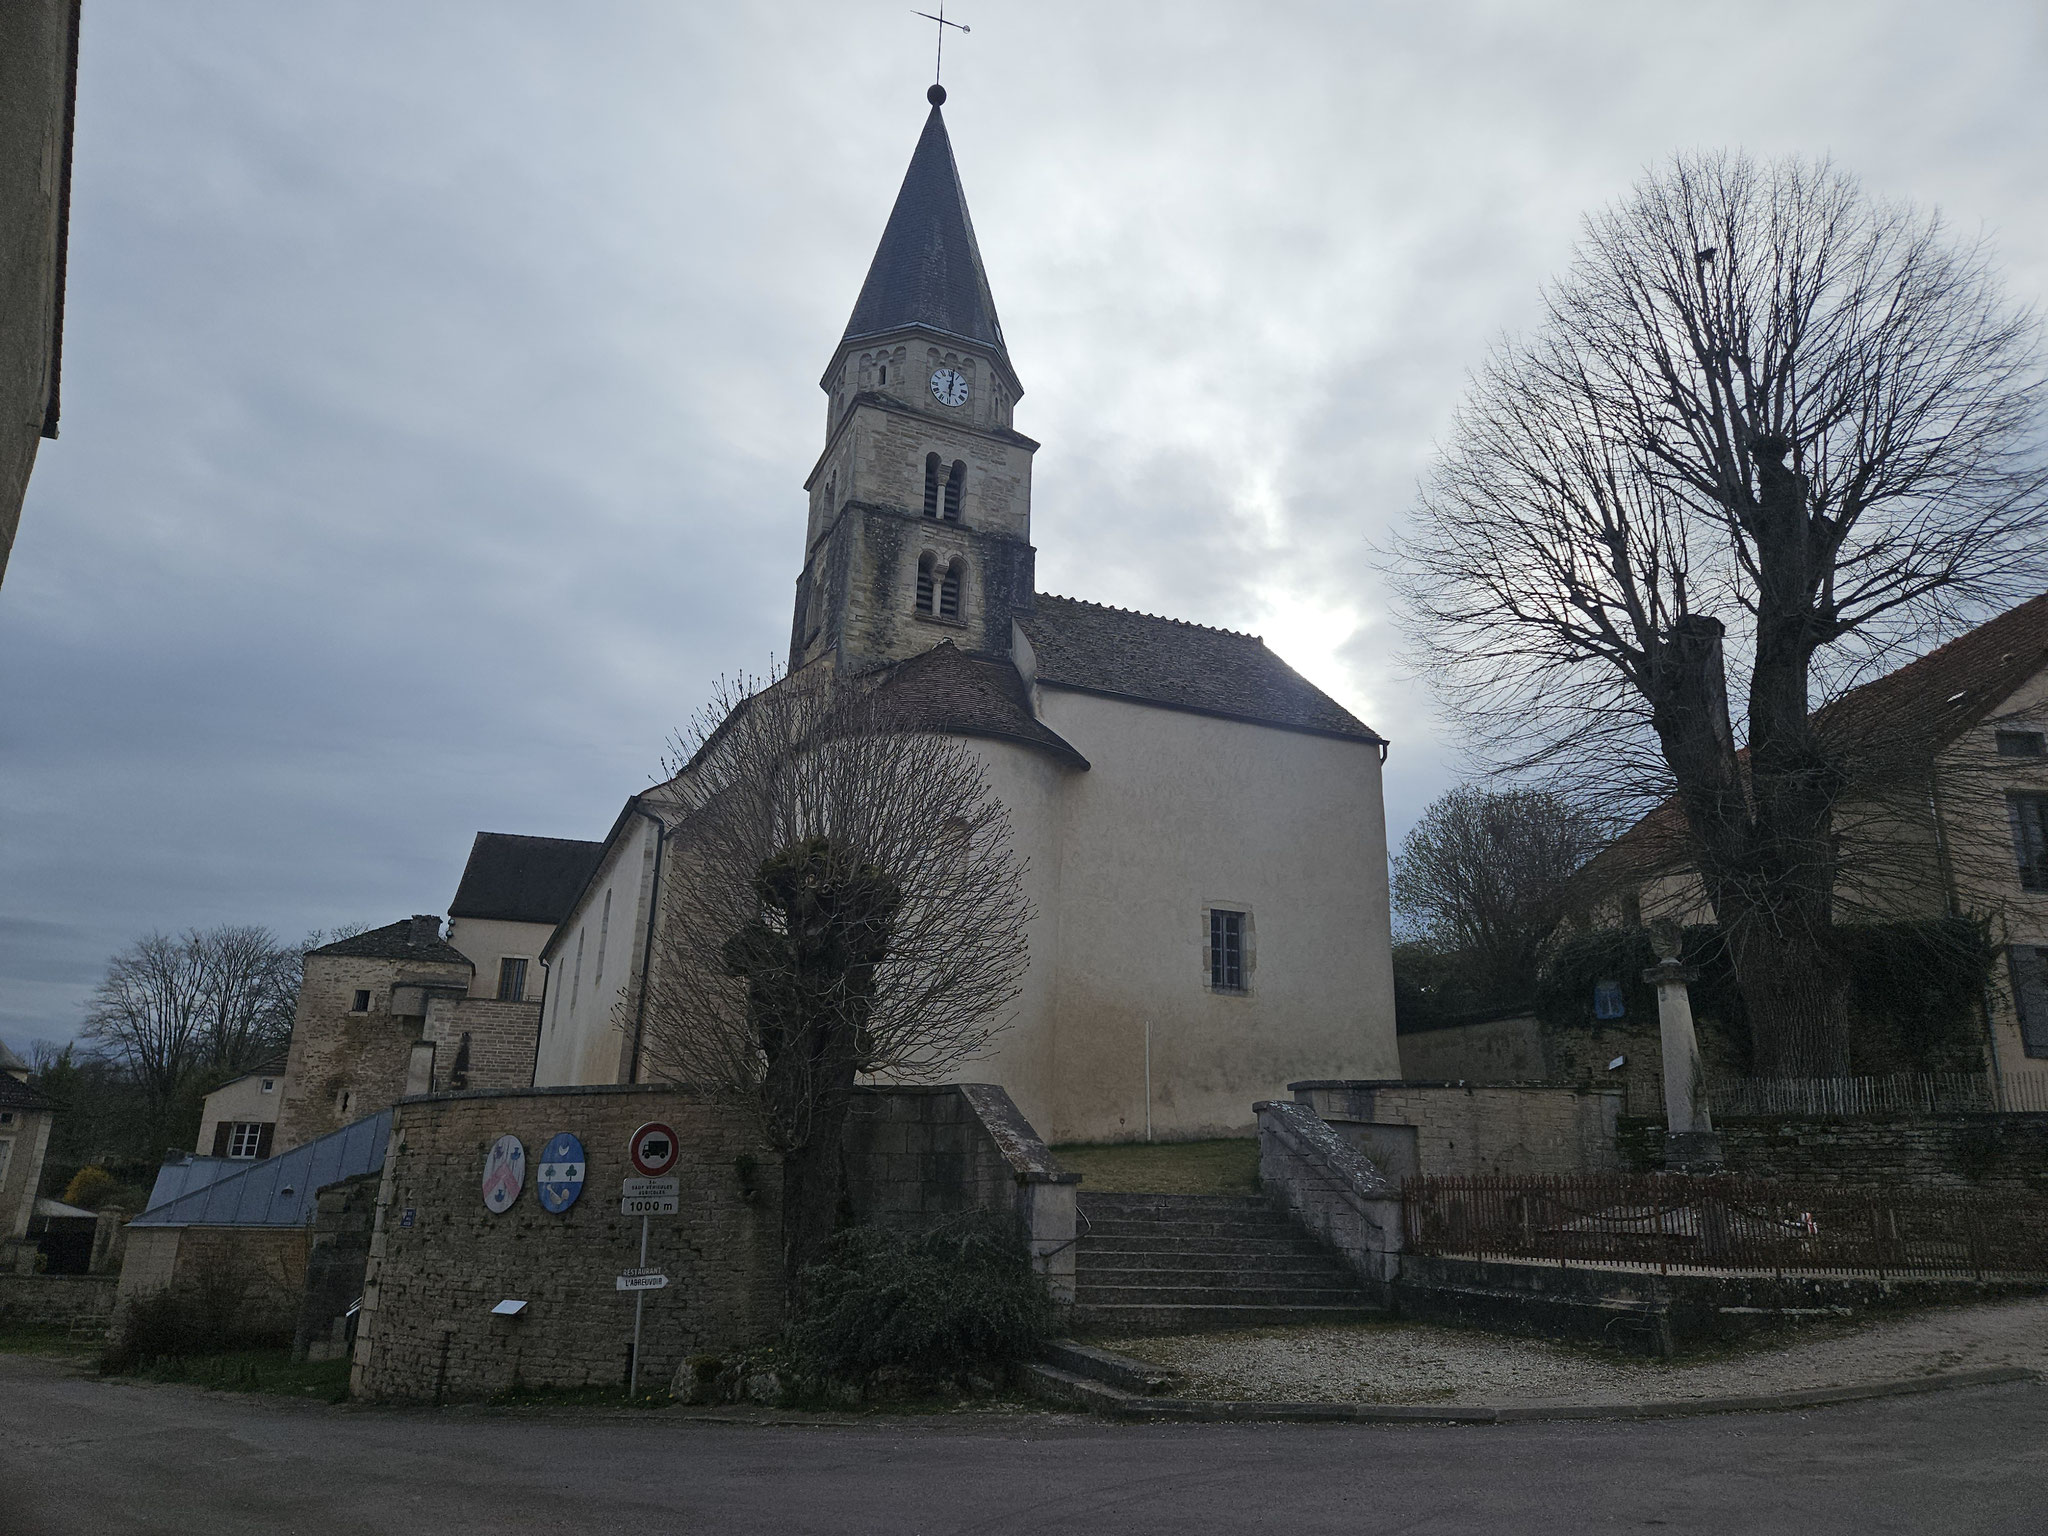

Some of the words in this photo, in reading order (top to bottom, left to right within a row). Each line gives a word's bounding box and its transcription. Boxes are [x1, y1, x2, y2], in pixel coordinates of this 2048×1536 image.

[630, 1201, 660, 1212] 1000
[663, 1203, 673, 1211] m
[623, 1266, 662, 1276] RESTAURANT
[625, 1277, 663, 1287] L'ABREUVOIR
